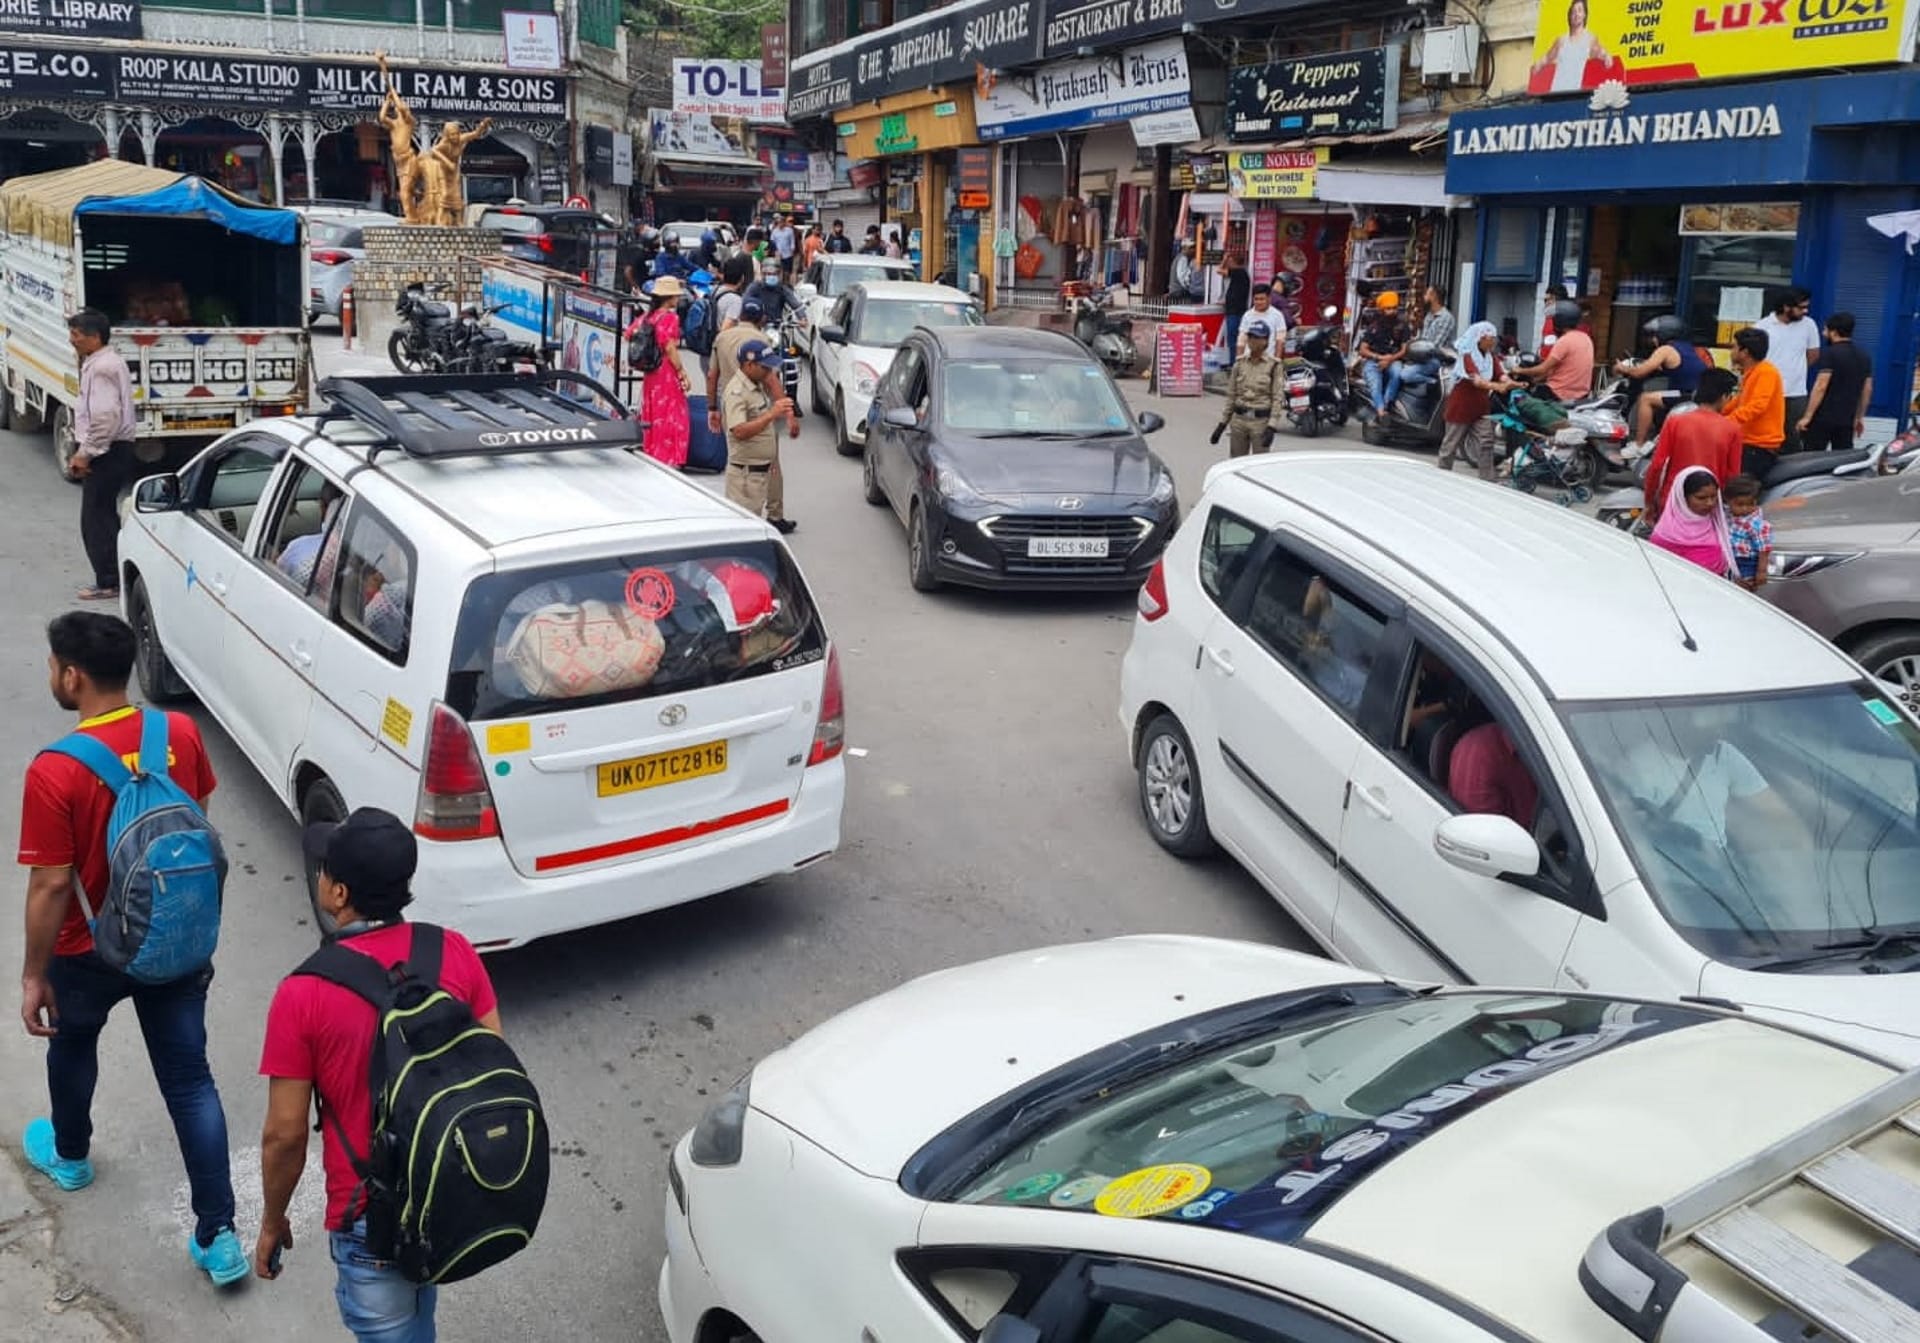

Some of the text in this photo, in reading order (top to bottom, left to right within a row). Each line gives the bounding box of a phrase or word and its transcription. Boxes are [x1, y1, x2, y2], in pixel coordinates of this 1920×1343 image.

[51, 0, 134, 22] LIBRARY
[1627, 1, 1662, 14] SUNO
[1694, 0, 1787, 33] LUX
[1047, 0, 1183, 47] RESTAURANT & BAR
[1635, 15, 1660, 28] TOH
[858, 3, 1030, 84] THE IMPERIAL SQUARE
[1620, 31, 1654, 45] APNE
[1629, 44, 1664, 58] DIL KI
[120, 57, 300, 87] ROOP KALA STUDIO
[1042, 66, 1108, 110] Prakash
[1130, 53, 1187, 87] Bros.
[1292, 61, 1361, 88] Peppers
[414, 73, 466, 98] RAM
[478, 77, 494, 97] &
[497, 78, 555, 100] SONS
[1264, 85, 1360, 113] Restaurant
[1453, 103, 1781, 155] LAXMI MISTHAN BHANDA
[1241, 151, 1315, 168] VEG NON VEG
[1277, 185, 1298, 195] FOOD
[509, 428, 597, 444] TOYOTA
